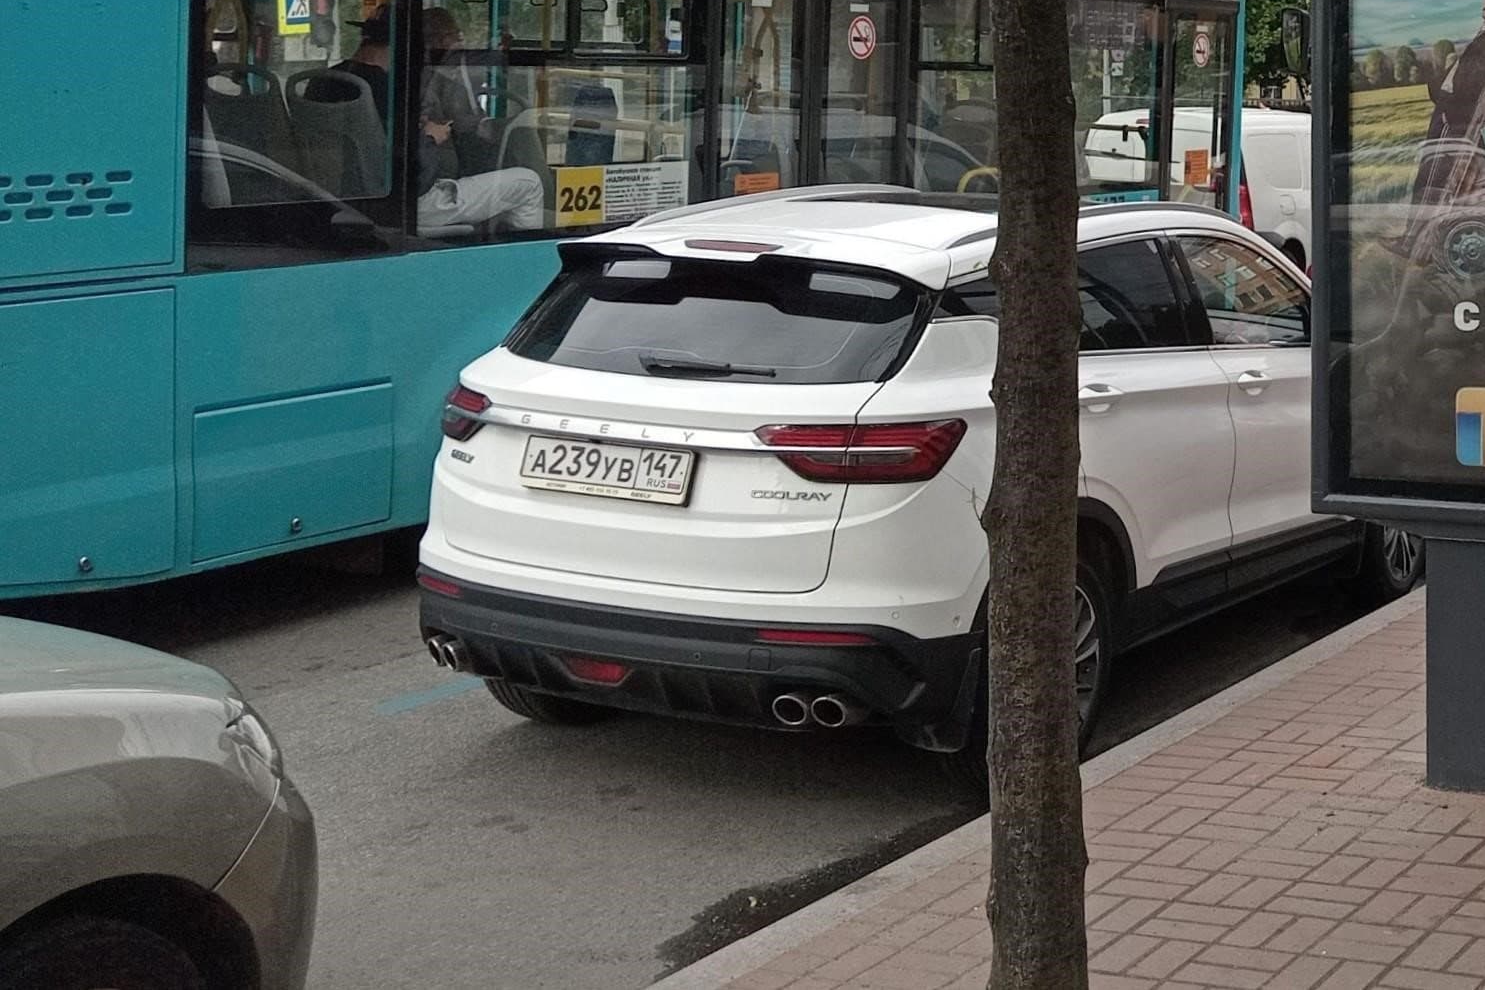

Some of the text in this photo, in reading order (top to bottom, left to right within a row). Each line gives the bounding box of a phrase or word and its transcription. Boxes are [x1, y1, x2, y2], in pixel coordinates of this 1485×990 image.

[560, 185, 603, 213] 262
[1453, 302, 1480, 332] С
[520, 414, 697, 443] GEELY
[642, 451, 681, 479] 147
[646, 478, 667, 489] RUS
[751, 489, 833, 503] COOLRAY
